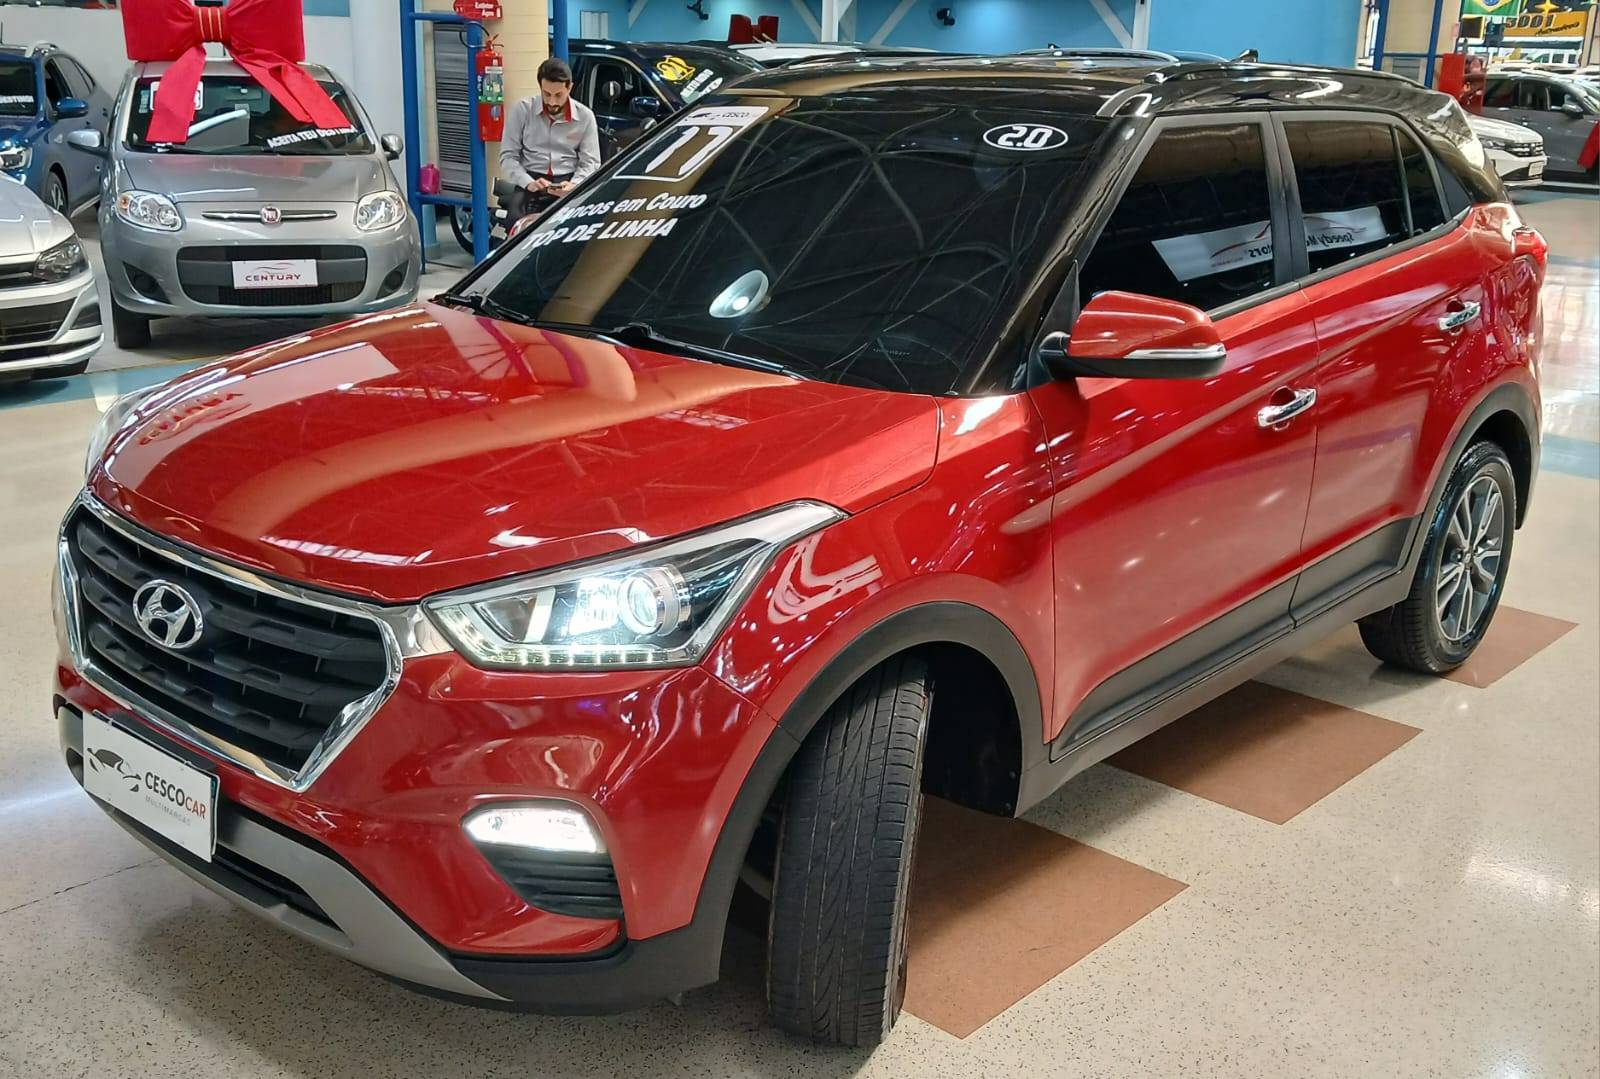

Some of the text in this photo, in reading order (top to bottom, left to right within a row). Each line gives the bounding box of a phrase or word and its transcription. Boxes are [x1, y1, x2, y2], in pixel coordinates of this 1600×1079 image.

[997, 126, 1053, 148] 2.0
[612, 197, 648, 213] em
[646, 192, 708, 211] Couro
[521, 218, 679, 251] TOP DE LINHA
[245, 274, 302, 282] CENTURY
[145, 771, 206, 820] CESCOCAR
